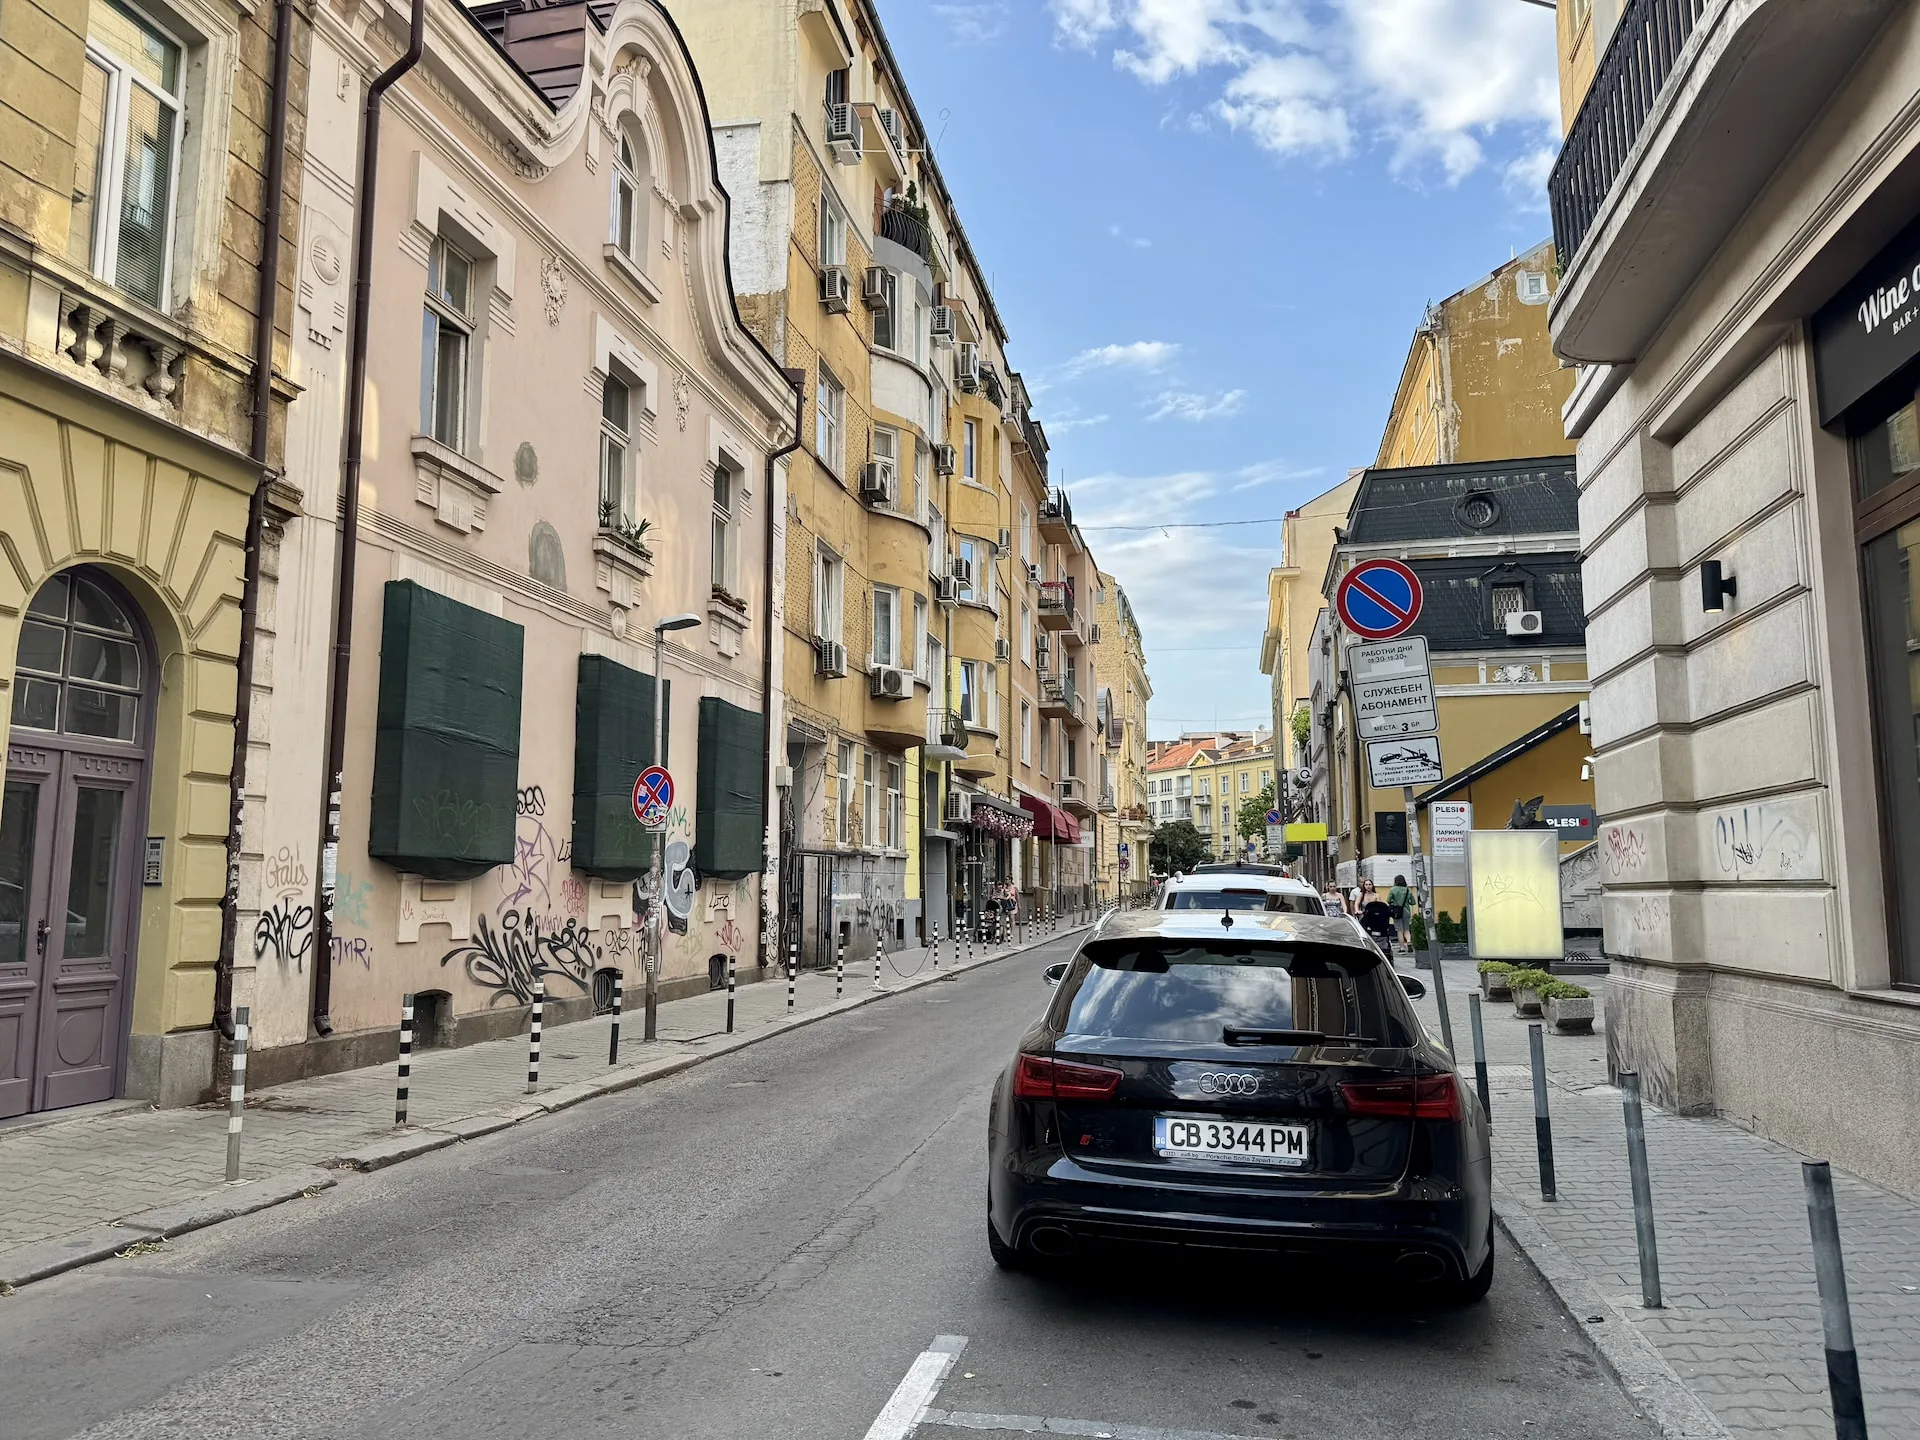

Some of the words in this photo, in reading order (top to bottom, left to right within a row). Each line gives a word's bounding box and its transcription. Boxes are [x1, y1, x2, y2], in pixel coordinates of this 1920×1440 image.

[1857, 276, 1910, 335] Wine
[1361, 648, 1396, 658] РАБОТНИ
[1397, 645, 1413, 653] ДНИ
[1363, 683, 1423, 698] СЛУЖЕБЕН
[1360, 695, 1428, 711] АБОНАМЕНТ
[1401, 722, 1409, 732] 3
[1156, 1136, 1166, 1145] BG
[1170, 1122, 1202, 1148] CB
[1206, 1124, 1266, 1152] 3344
[1271, 1129, 1303, 1155] PM
